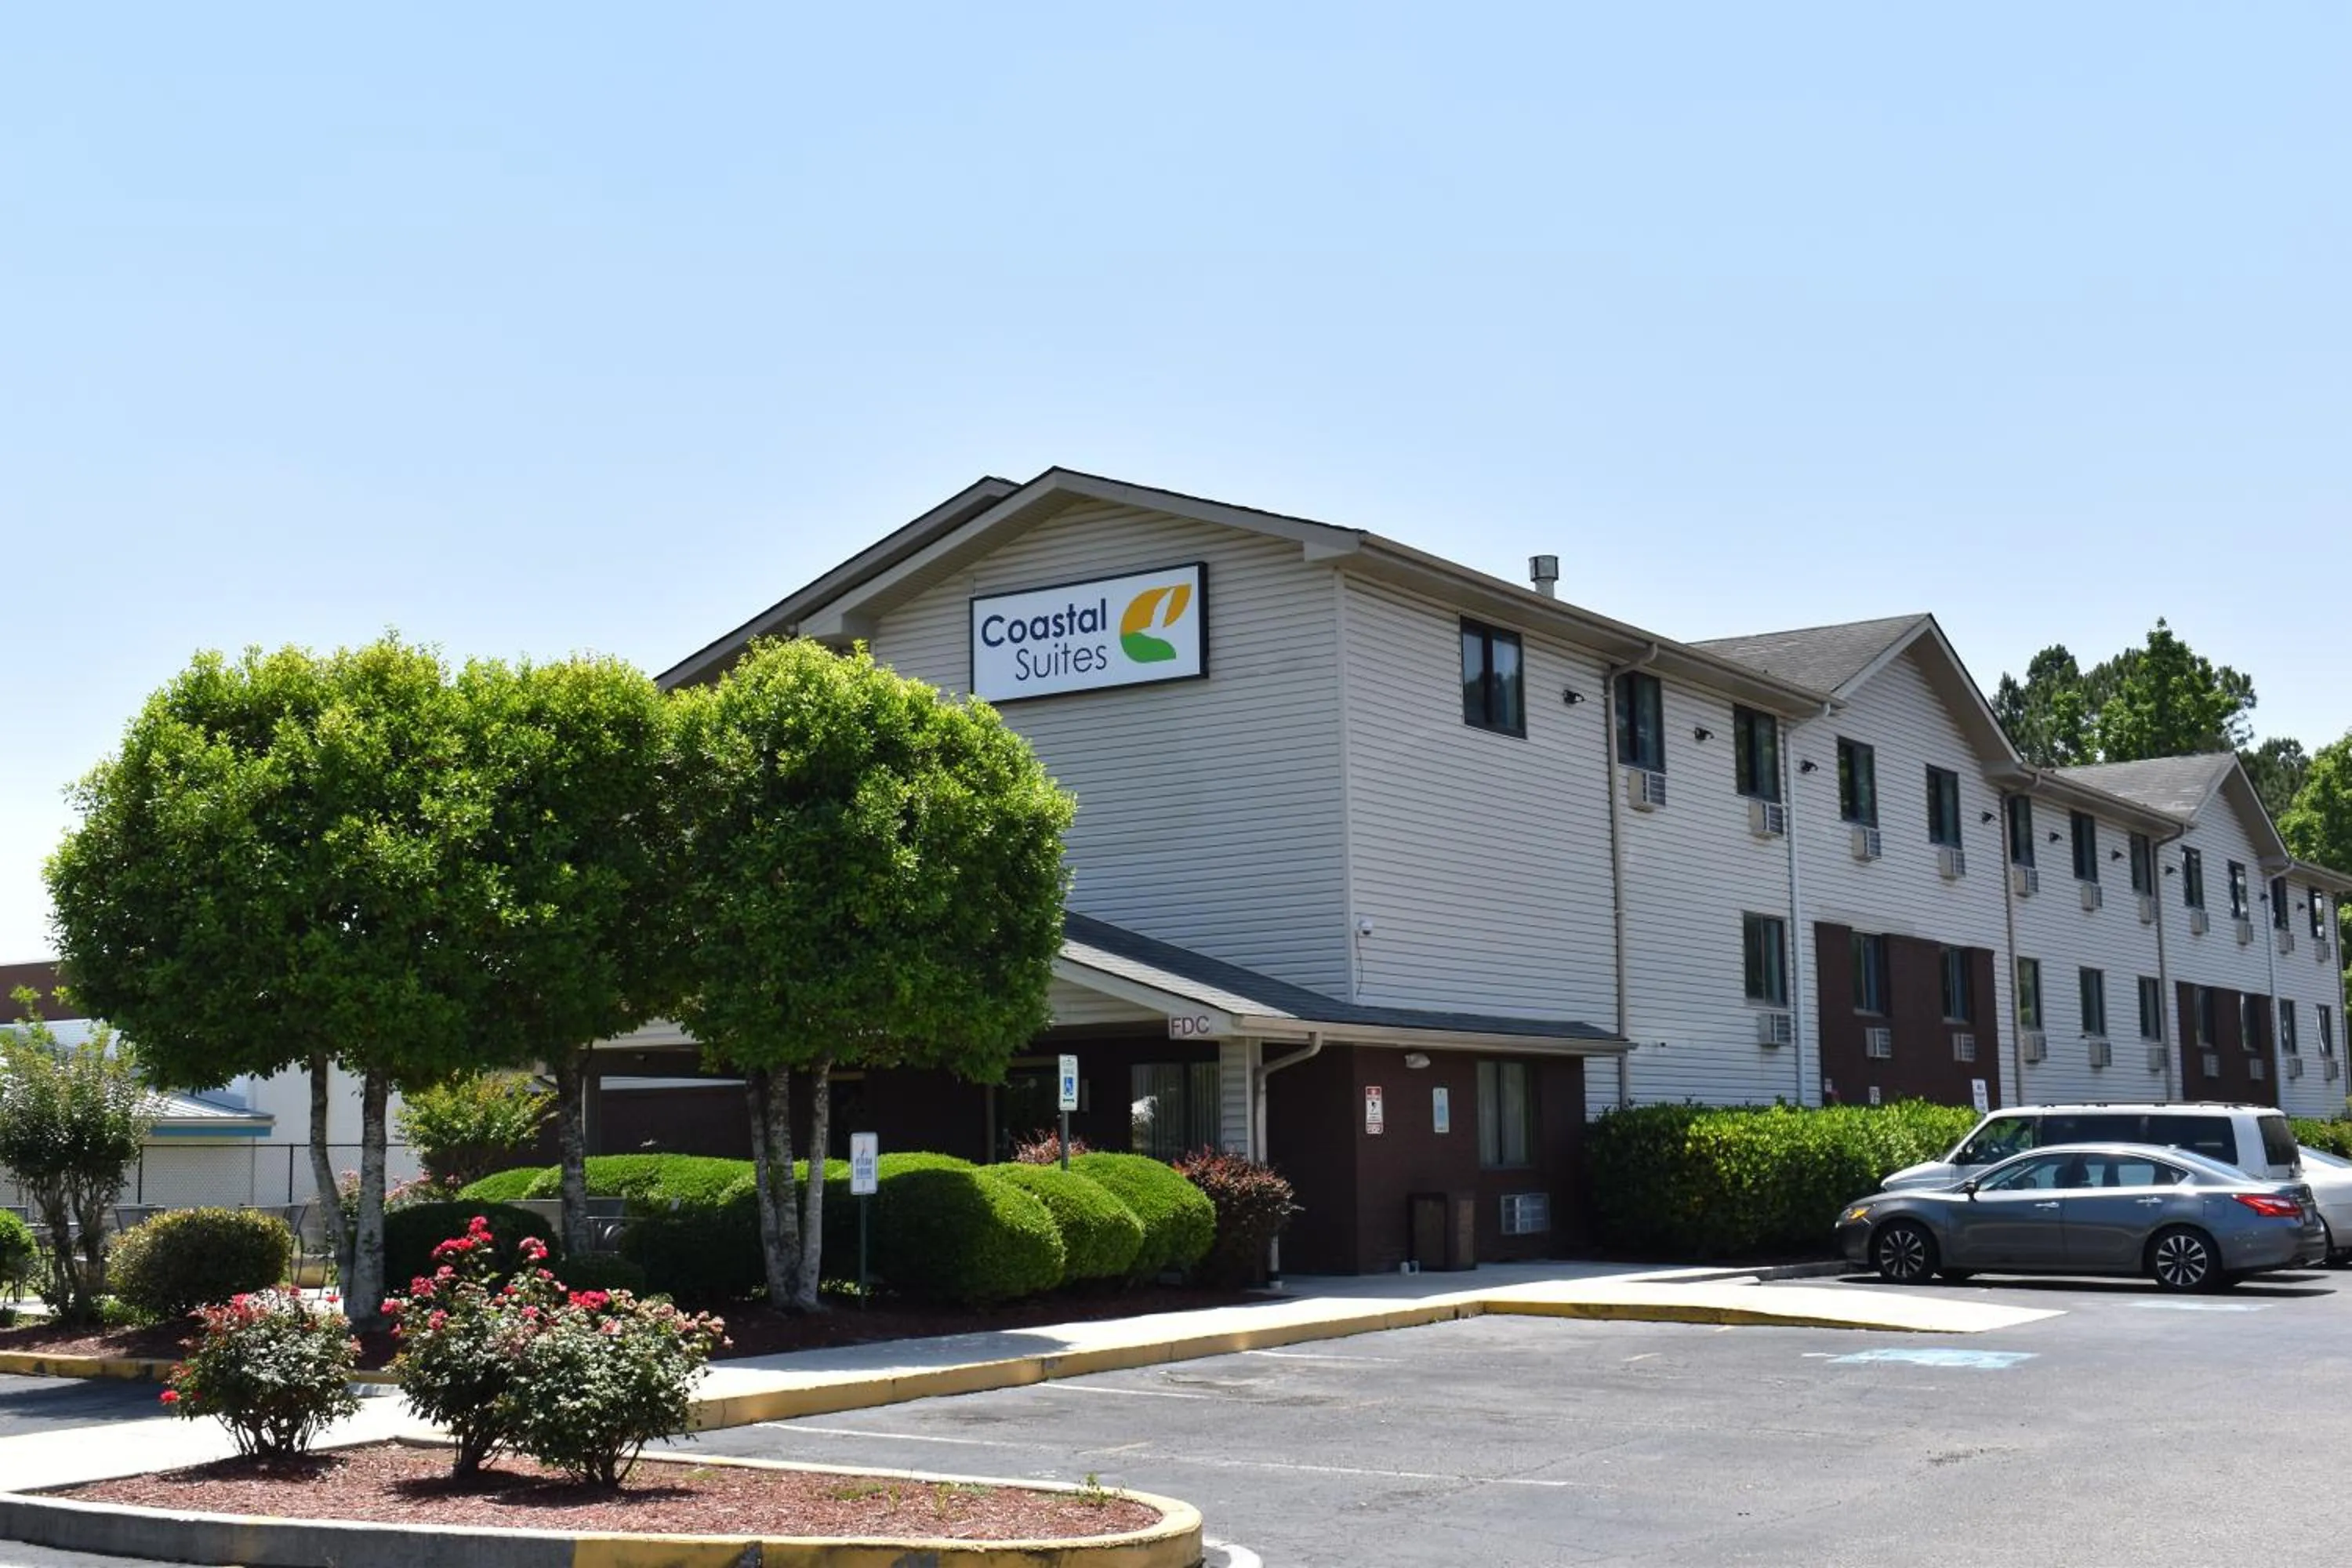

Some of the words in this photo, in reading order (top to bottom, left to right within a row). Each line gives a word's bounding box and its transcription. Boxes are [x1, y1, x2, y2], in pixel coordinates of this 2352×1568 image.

[982, 598, 1106, 647] Coastal
[1015, 643, 1107, 681] Suites
[1171, 1015, 1210, 1036] FDC
